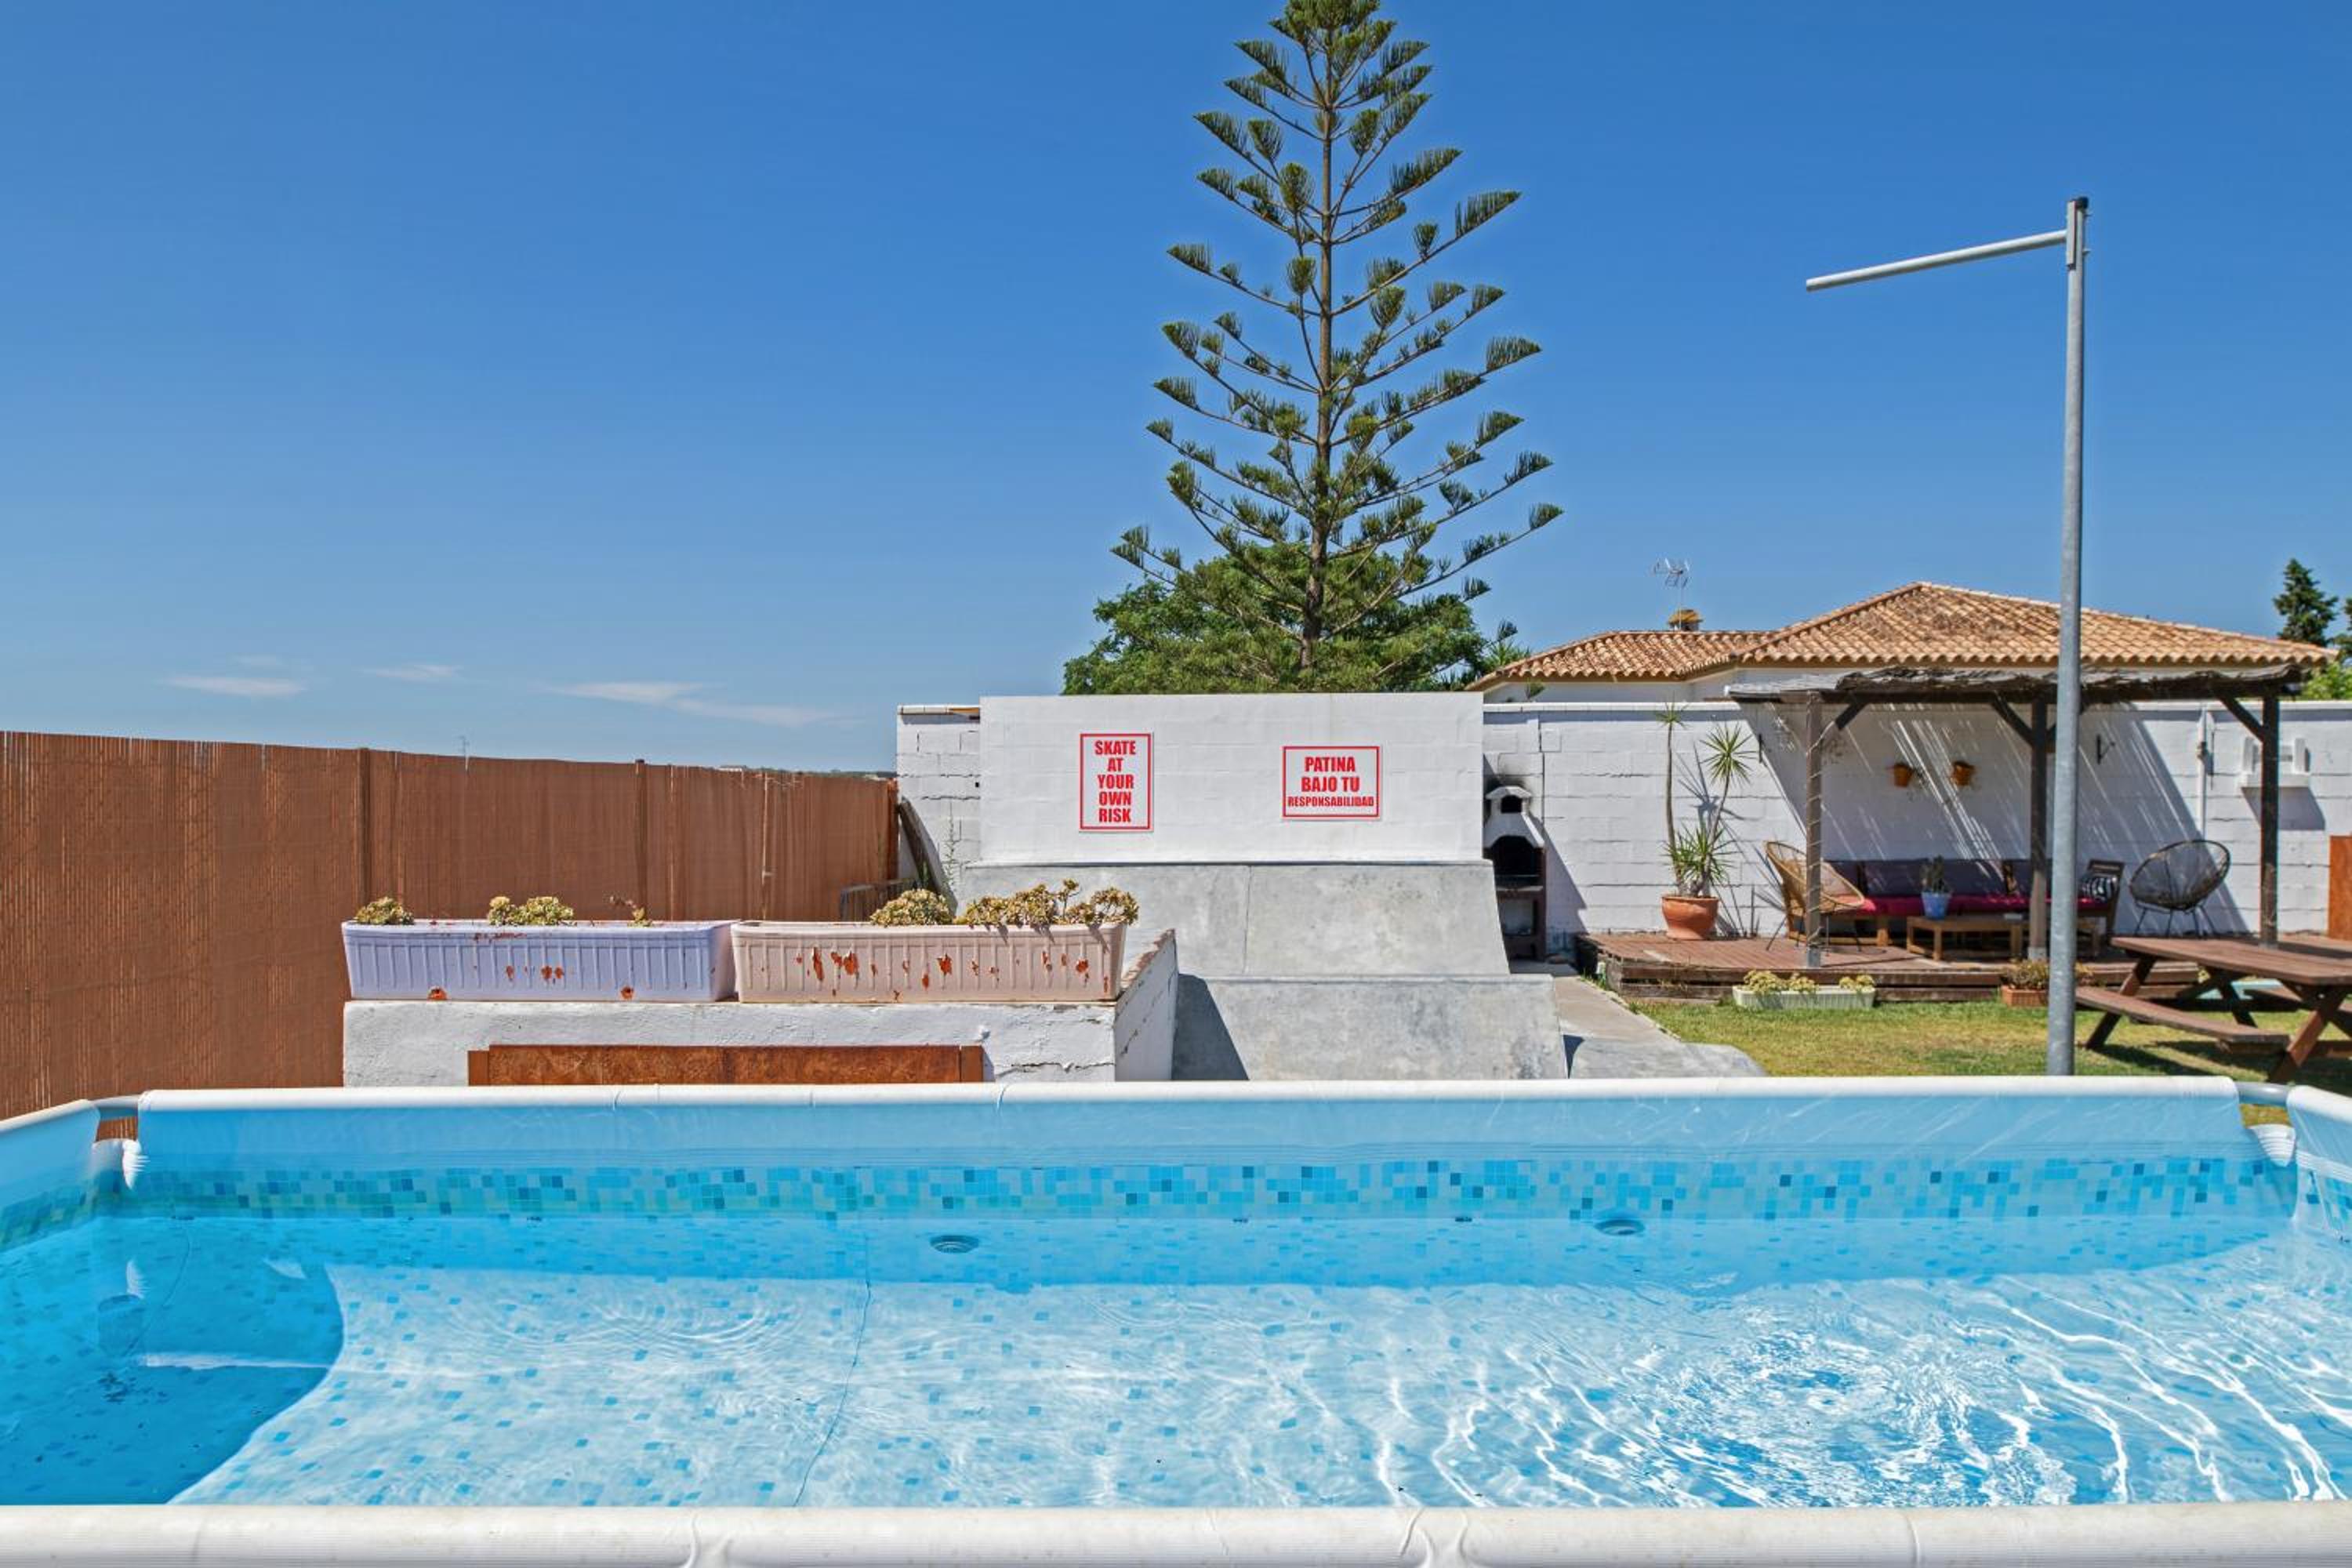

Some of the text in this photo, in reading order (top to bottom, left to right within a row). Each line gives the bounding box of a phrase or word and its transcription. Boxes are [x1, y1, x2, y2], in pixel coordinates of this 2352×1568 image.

[1094, 740, 1136, 755] SKATE
[1107, 757, 1123, 772] AT
[1305, 756, 1356, 773] PATINA
[1097, 774, 1134, 789] YOUR
[1301, 776, 1360, 793] BAJO TU
[1098, 791, 1131, 806] OWN
[1287, 795, 1374, 808] RESPONSABILIDAD
[1098, 808, 1131, 822] RISK
